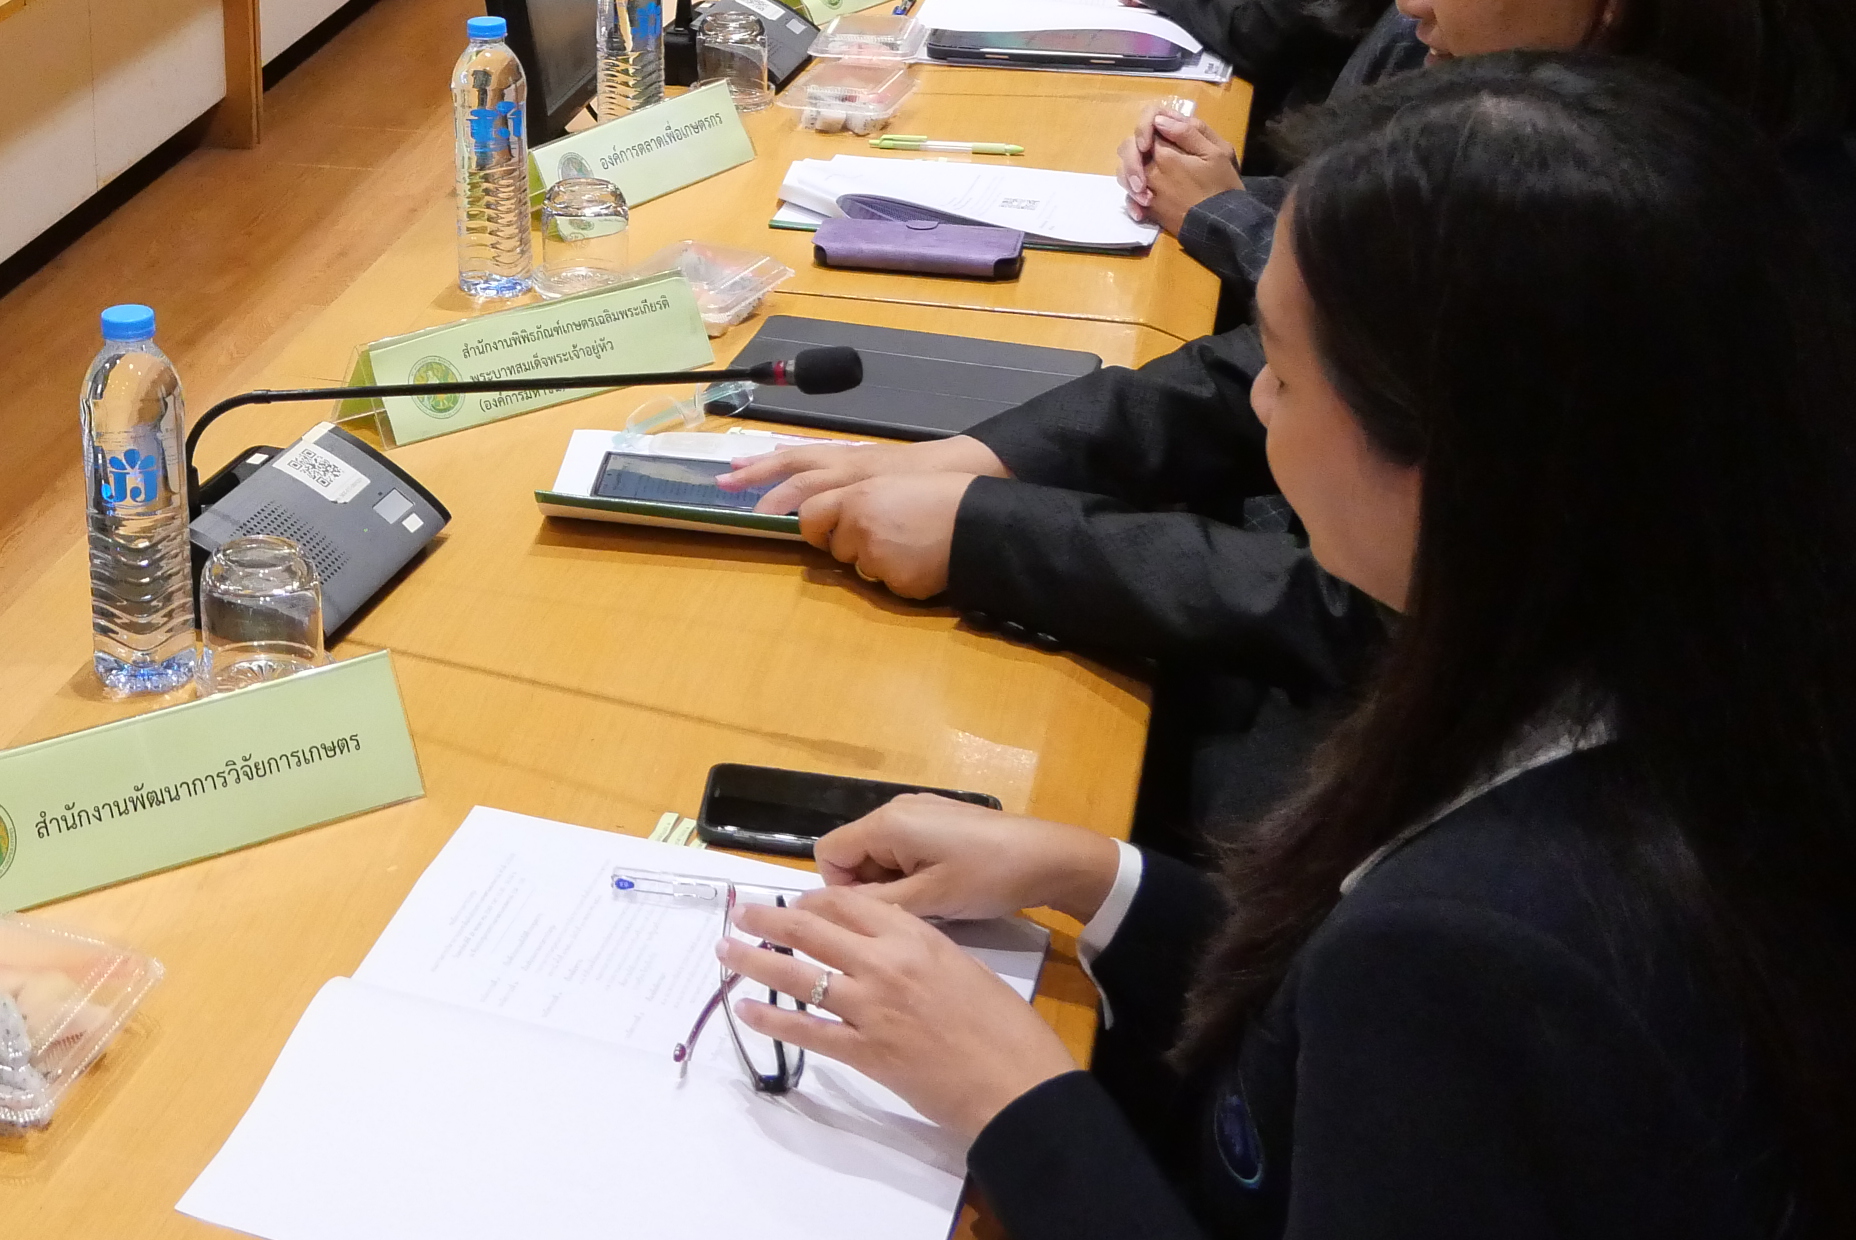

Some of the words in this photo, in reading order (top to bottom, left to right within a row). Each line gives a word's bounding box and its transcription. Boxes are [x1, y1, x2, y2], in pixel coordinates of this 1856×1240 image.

[599, 110, 724, 171] องค์การตลาดเพื่อเกษตรกร
[461, 294, 671, 360] สำนักงานพิพิธภัณฑ์เกษตรเฉลิมพระเกียรติ
[469, 337, 615, 382] พระบาทสมเด็จพระเจ้าอยู่หัว
[33, 730, 363, 841] สำนักงานพัฒนาการวิจัยการเกษตร
